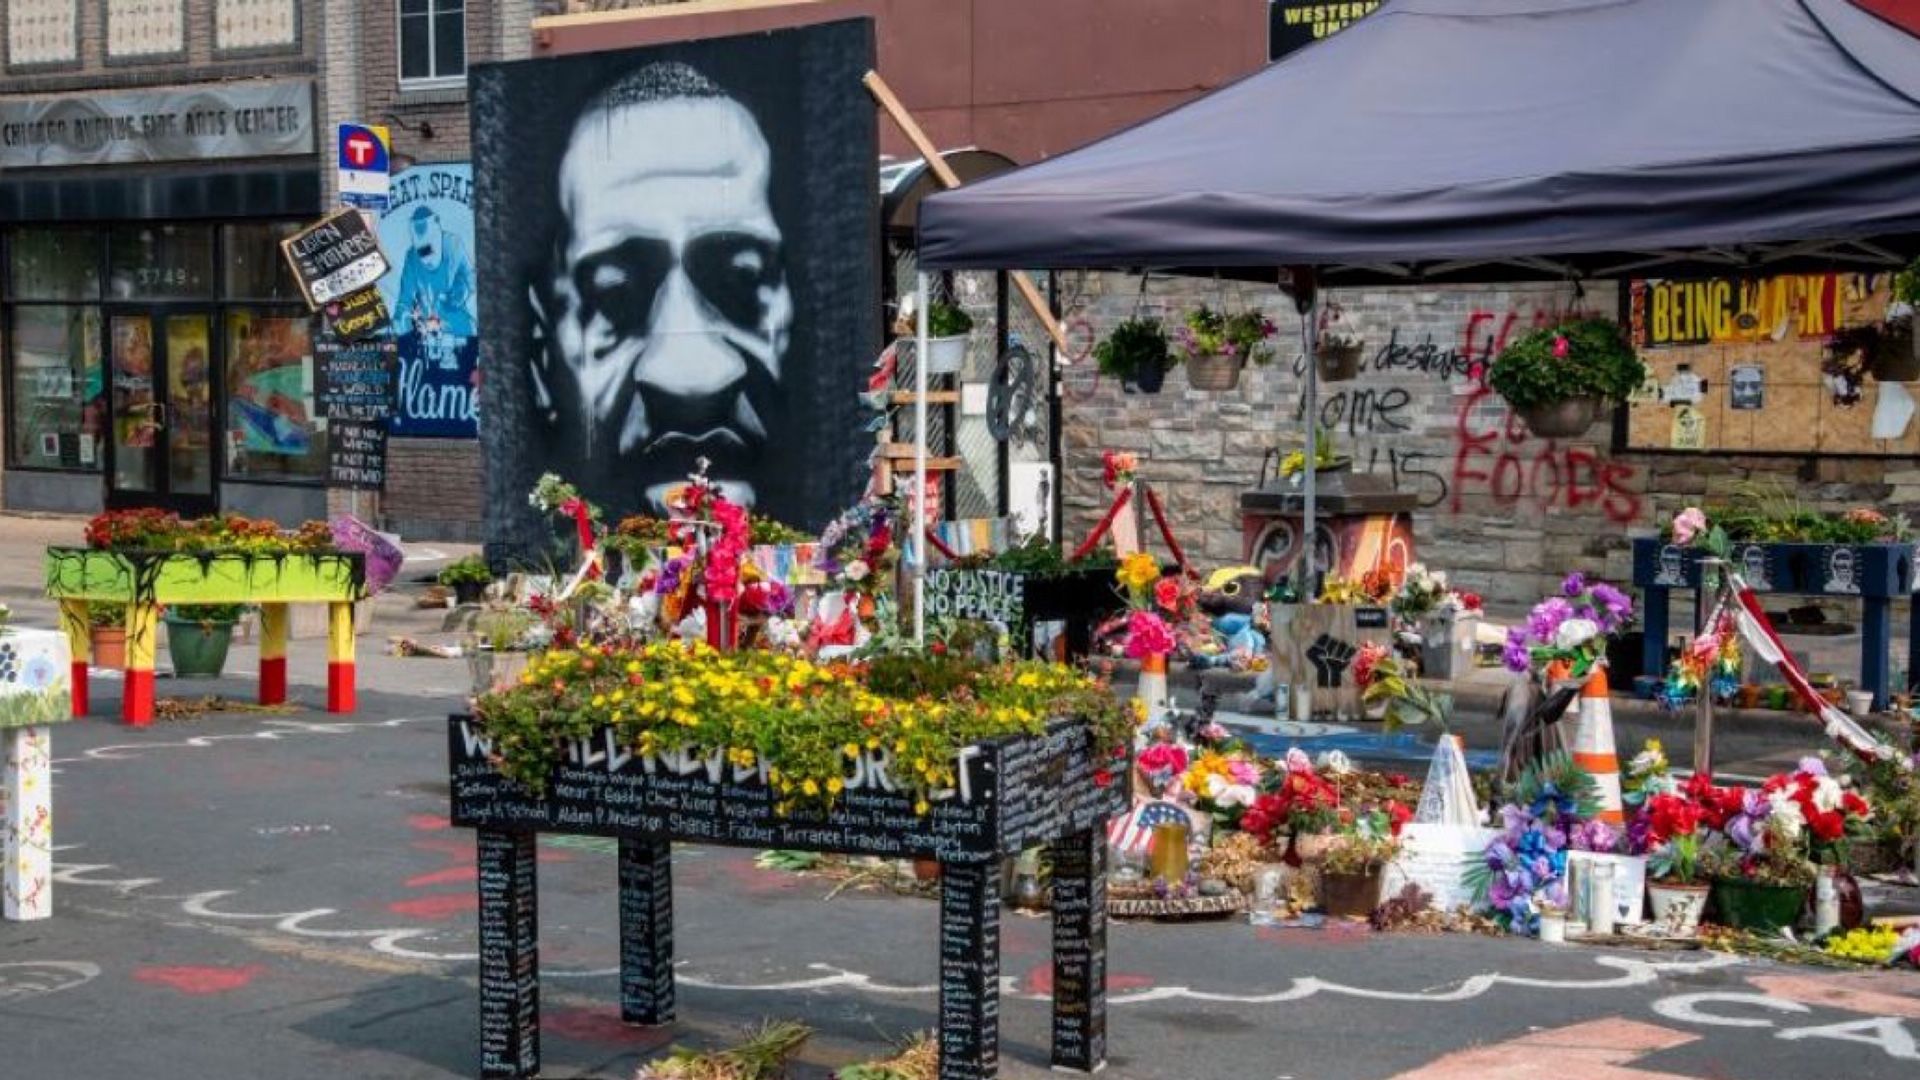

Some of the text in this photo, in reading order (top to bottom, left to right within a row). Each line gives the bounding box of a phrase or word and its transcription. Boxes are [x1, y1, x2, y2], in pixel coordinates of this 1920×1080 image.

[185, 109, 226, 136] ARTS
[235, 105, 299, 135] CENTER
[348, 139, 372, 165] T
[1652, 281, 1732, 342] BEING
[1452, 442, 1641, 520] FOODS
[924, 568, 1024, 601] NO JUSTICE
[924, 594, 1012, 622] NO PEACE
[459, 720, 494, 758] W
